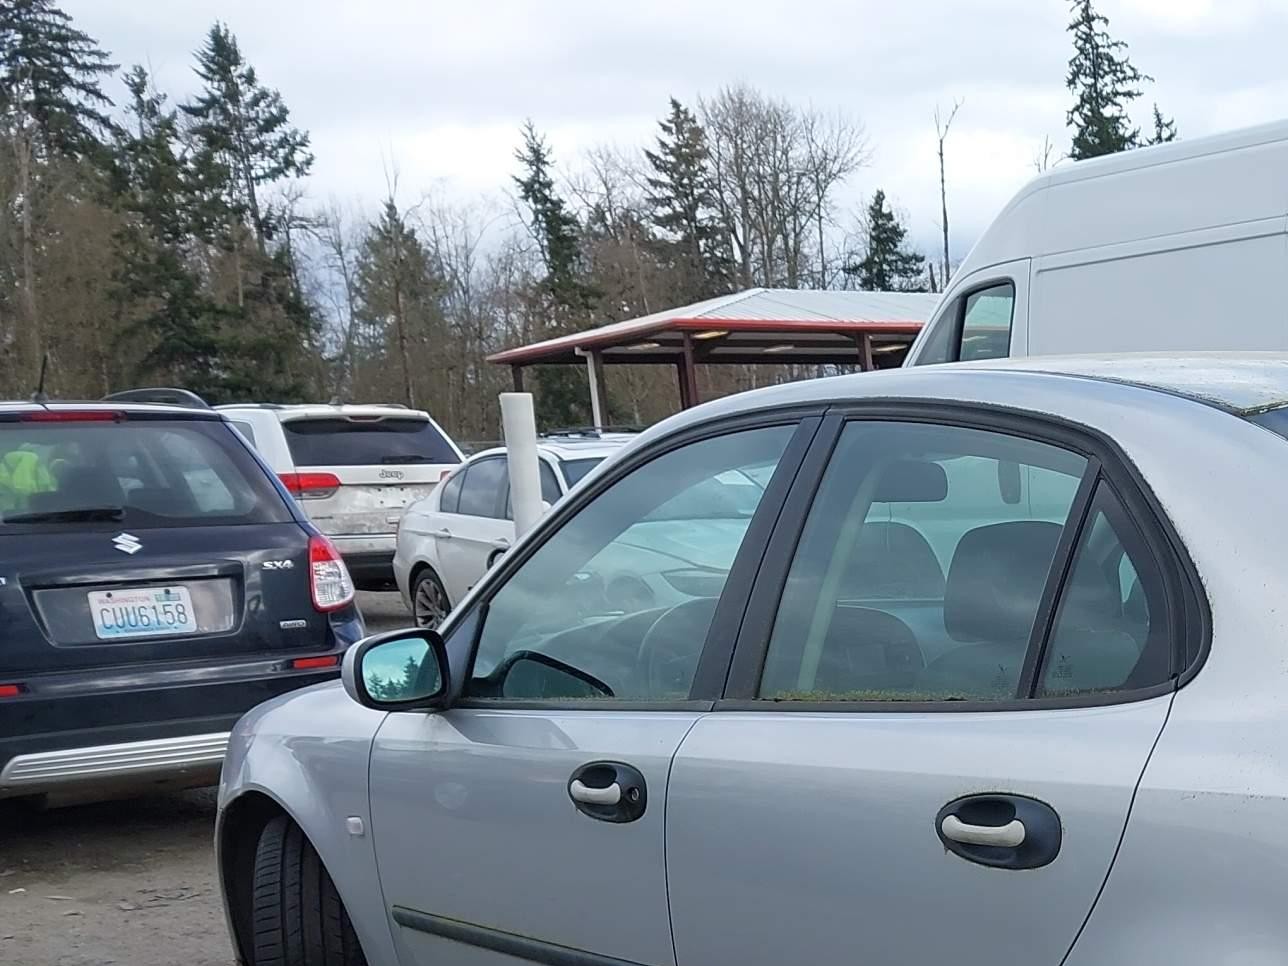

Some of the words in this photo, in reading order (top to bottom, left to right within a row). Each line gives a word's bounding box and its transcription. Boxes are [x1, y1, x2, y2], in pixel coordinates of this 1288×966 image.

[379, 469, 404, 480] Jeep
[262, 560, 294, 570] SX4
[100, 604, 187, 629] CUU6158
